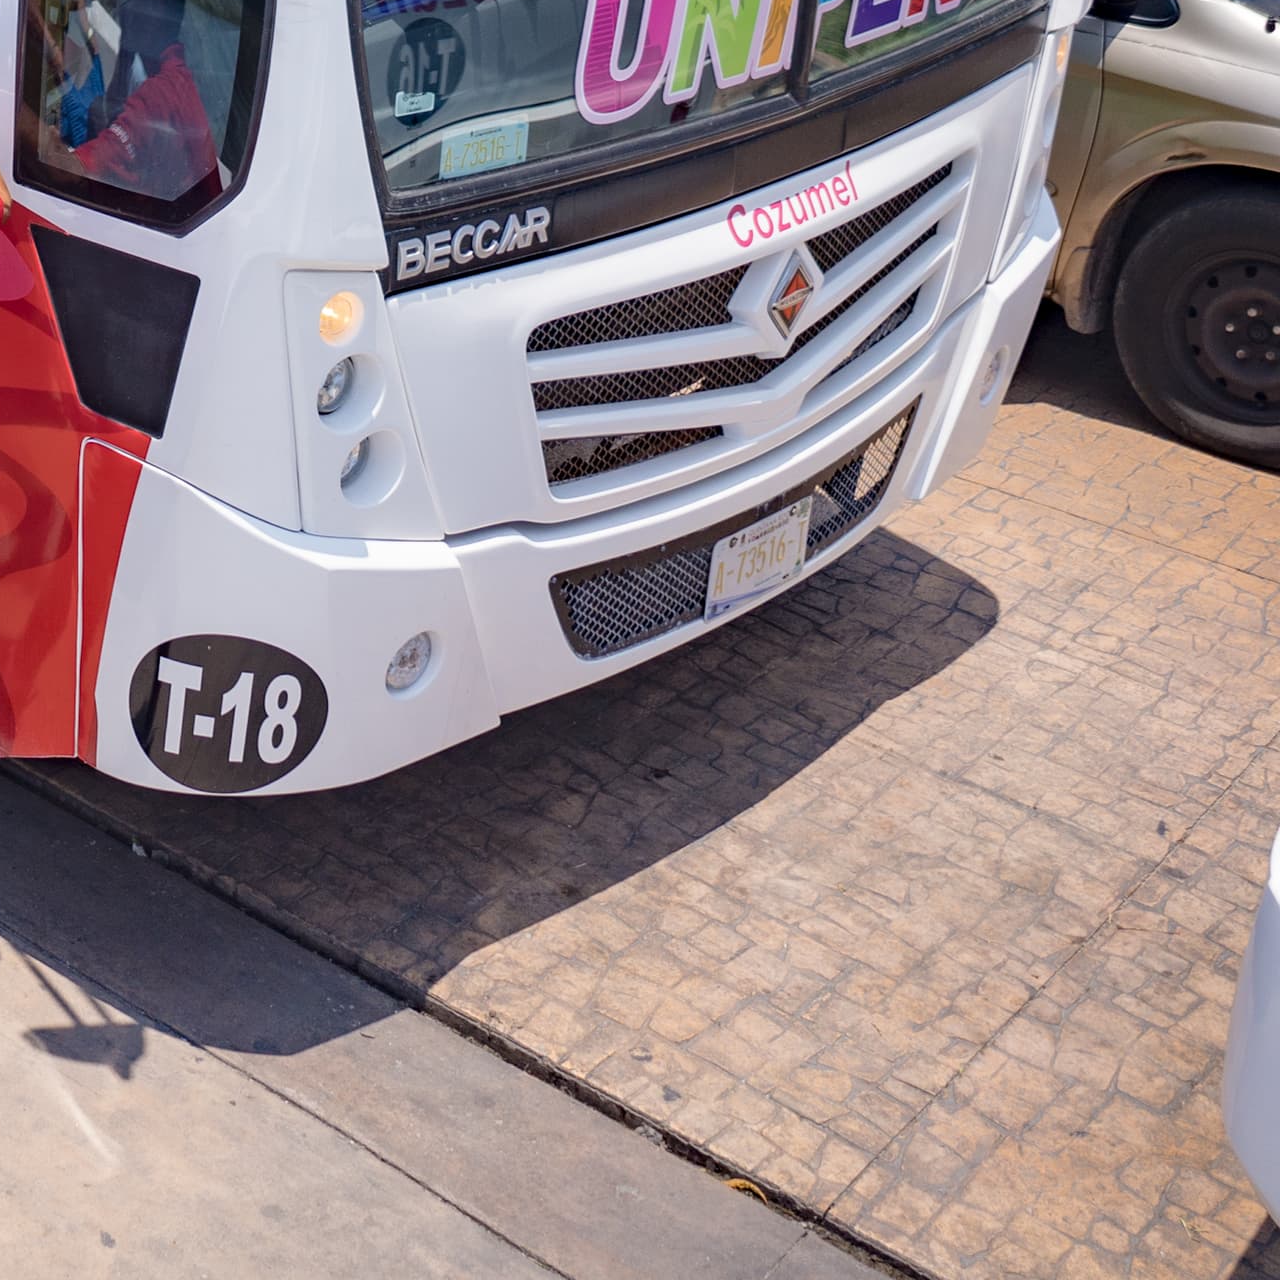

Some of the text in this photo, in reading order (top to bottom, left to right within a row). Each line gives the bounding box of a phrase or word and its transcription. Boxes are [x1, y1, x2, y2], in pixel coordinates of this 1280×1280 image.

[443, 131, 522, 173] A-73516-T
[727, 160, 858, 248] Cozumel
[397, 206, 549, 281] BECCAR
[713, 520, 808, 597] A-73516-T
[157, 655, 302, 765] T-18
